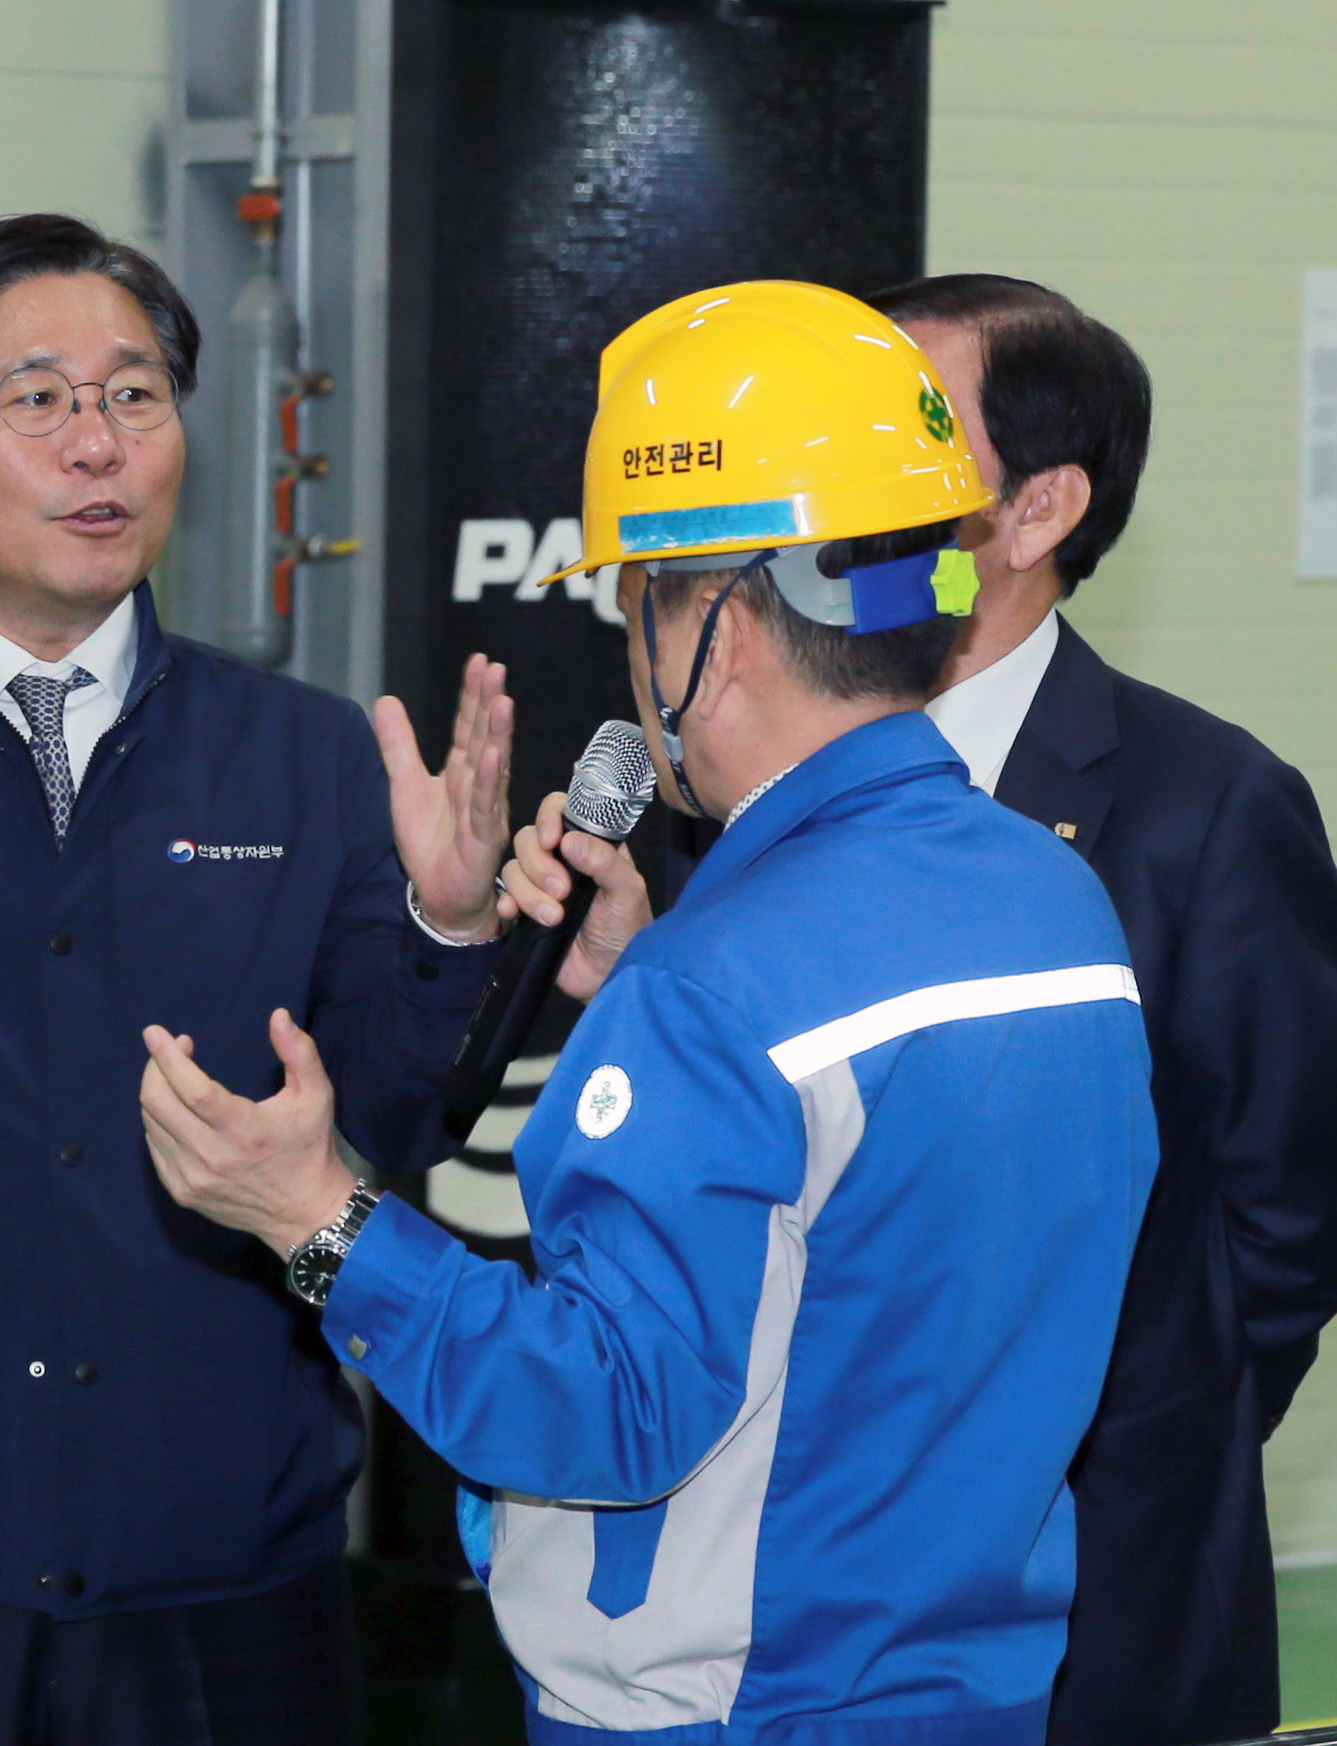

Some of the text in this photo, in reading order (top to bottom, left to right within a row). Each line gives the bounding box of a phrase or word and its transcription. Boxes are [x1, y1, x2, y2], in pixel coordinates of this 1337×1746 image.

[622, 439, 723, 480] 안전관리
[451, 518, 629, 629] PA
[197, 844, 284, 860] 산업통상자원부
